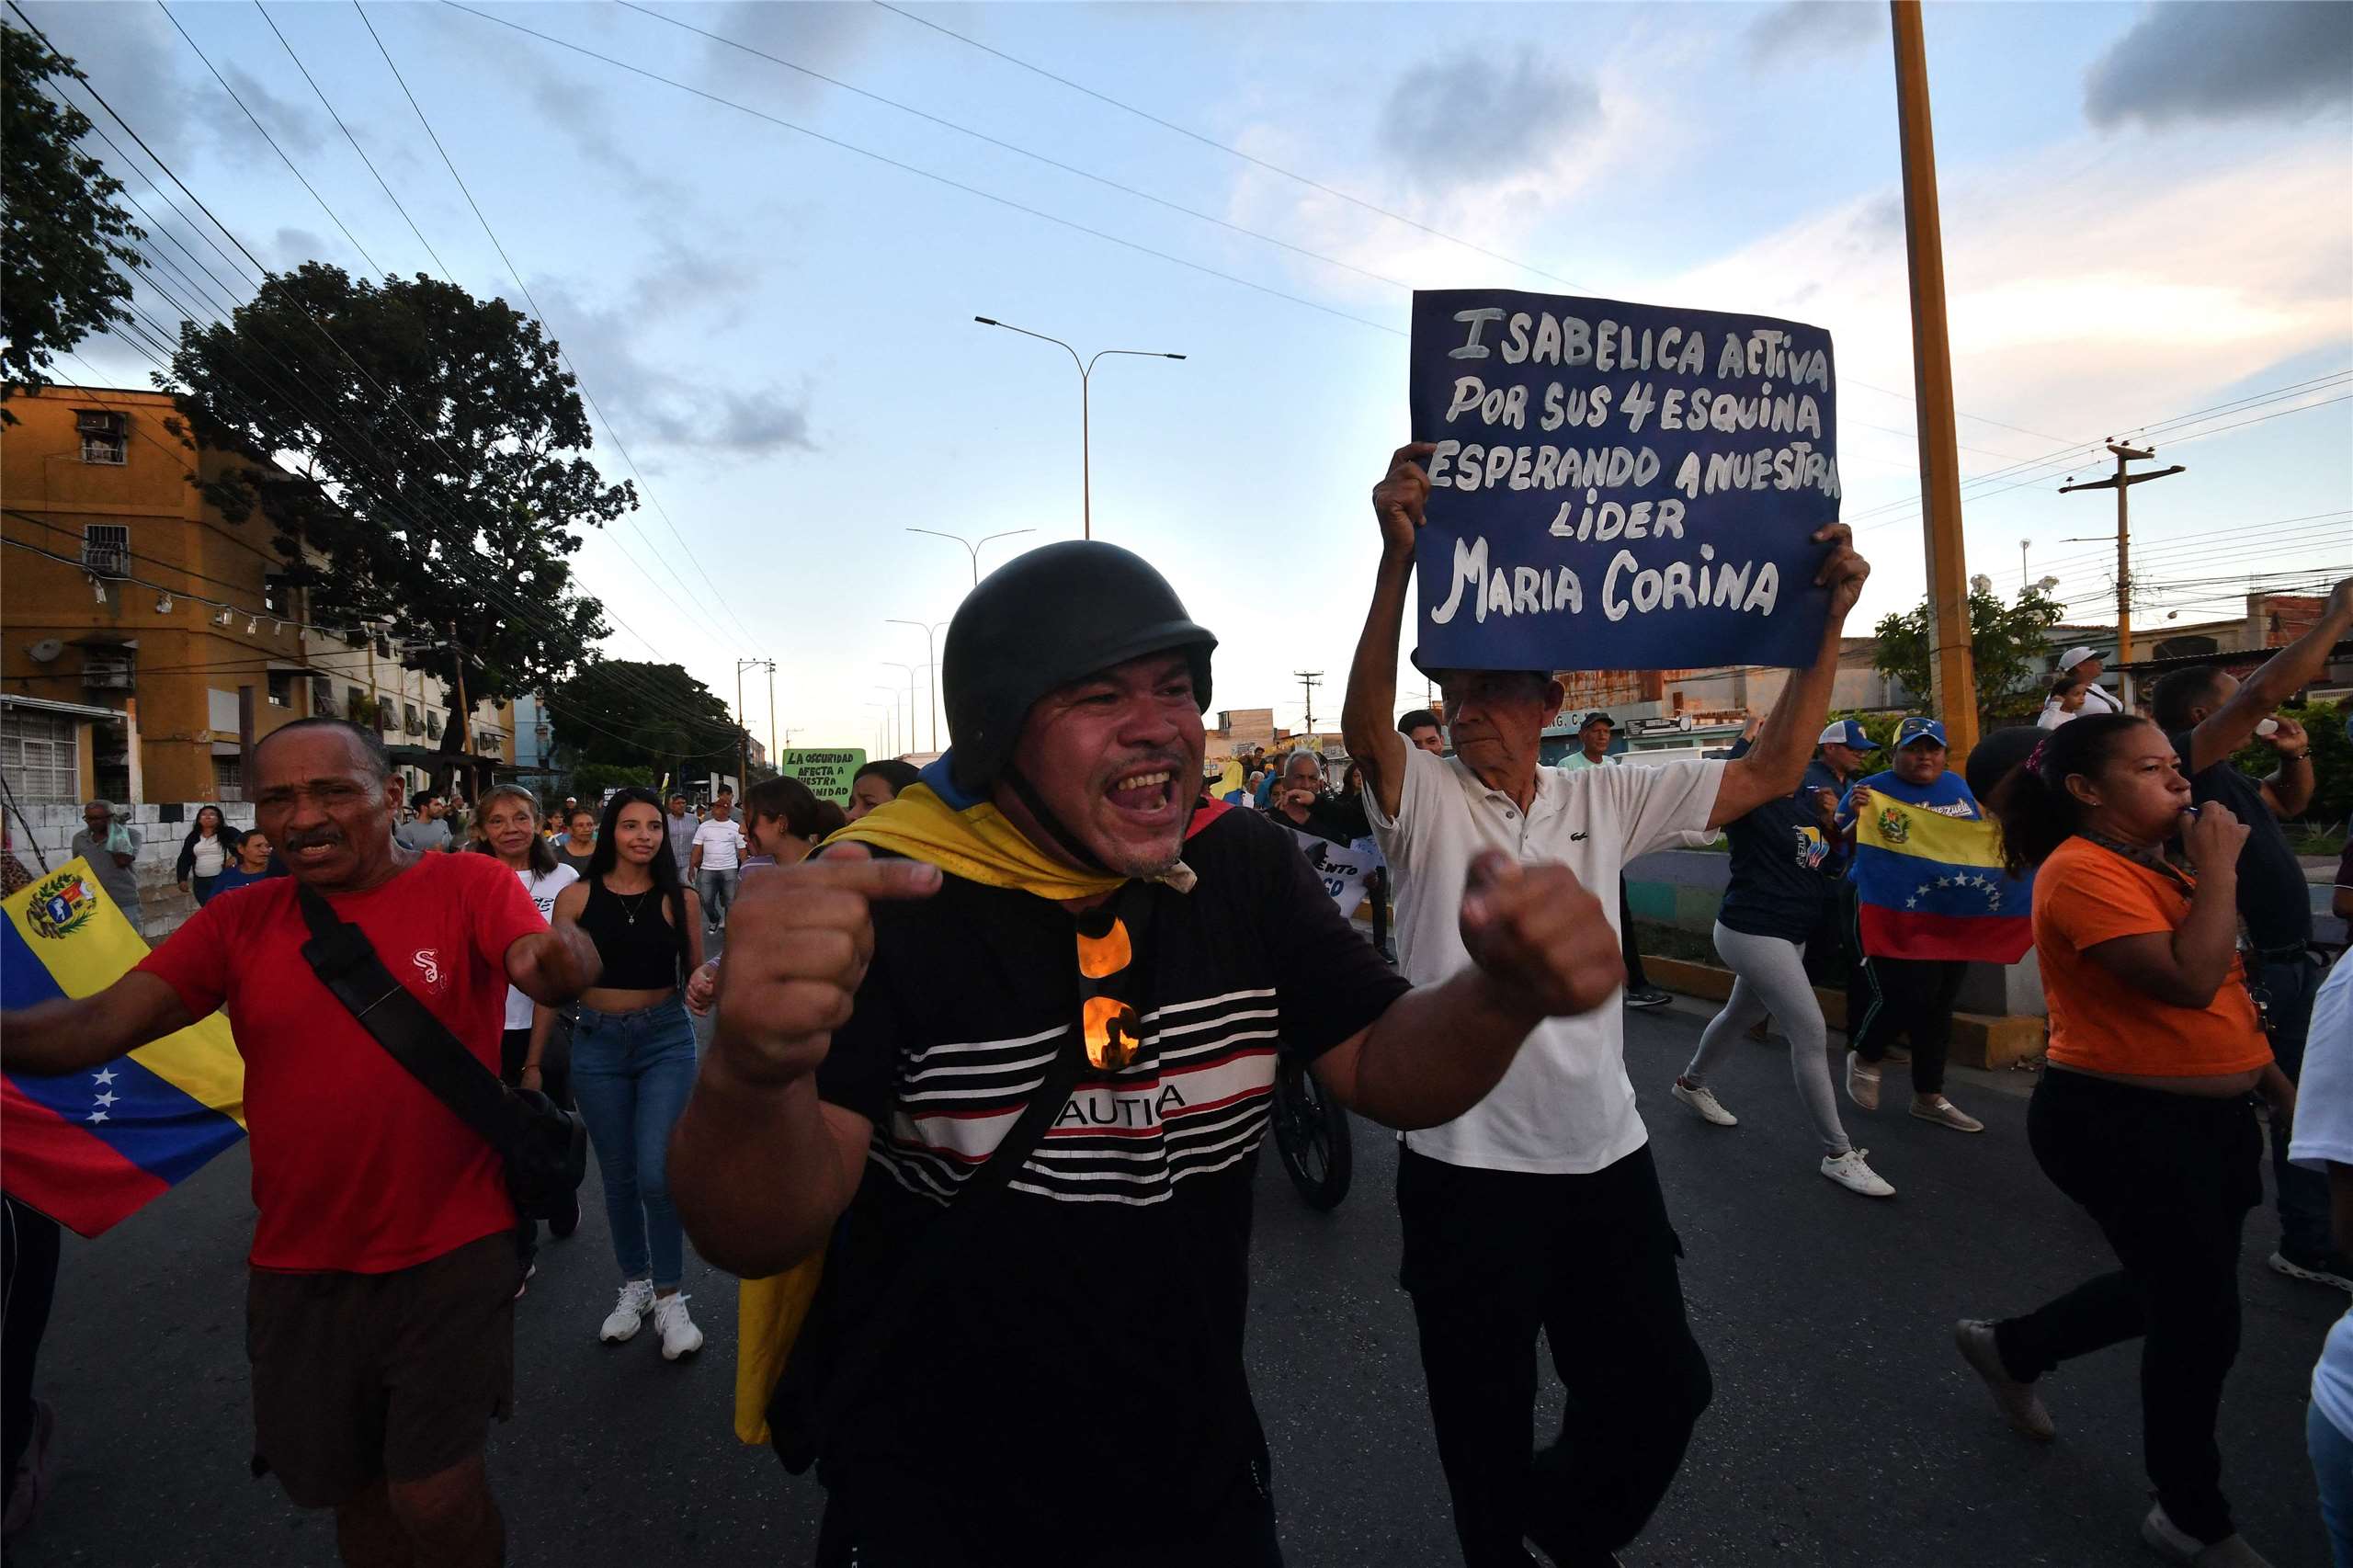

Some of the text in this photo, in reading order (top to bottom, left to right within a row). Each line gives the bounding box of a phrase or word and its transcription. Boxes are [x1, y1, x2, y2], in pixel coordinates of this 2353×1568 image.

[1448, 306, 1705, 376] ISABELICA
[1445, 375, 1529, 430] POR
[1540, 381, 1612, 434] SUS
[1620, 380, 1656, 433] 4
[1427, 438, 1841, 499] ESPERANDO A NUESTRA
[787, 752, 854, 765] LA OSCURIDAD
[798, 766, 845, 777] AFECTA A
[797, 776, 836, 786] UESTRA
[1055, 1085, 1186, 1127] AUTIA
